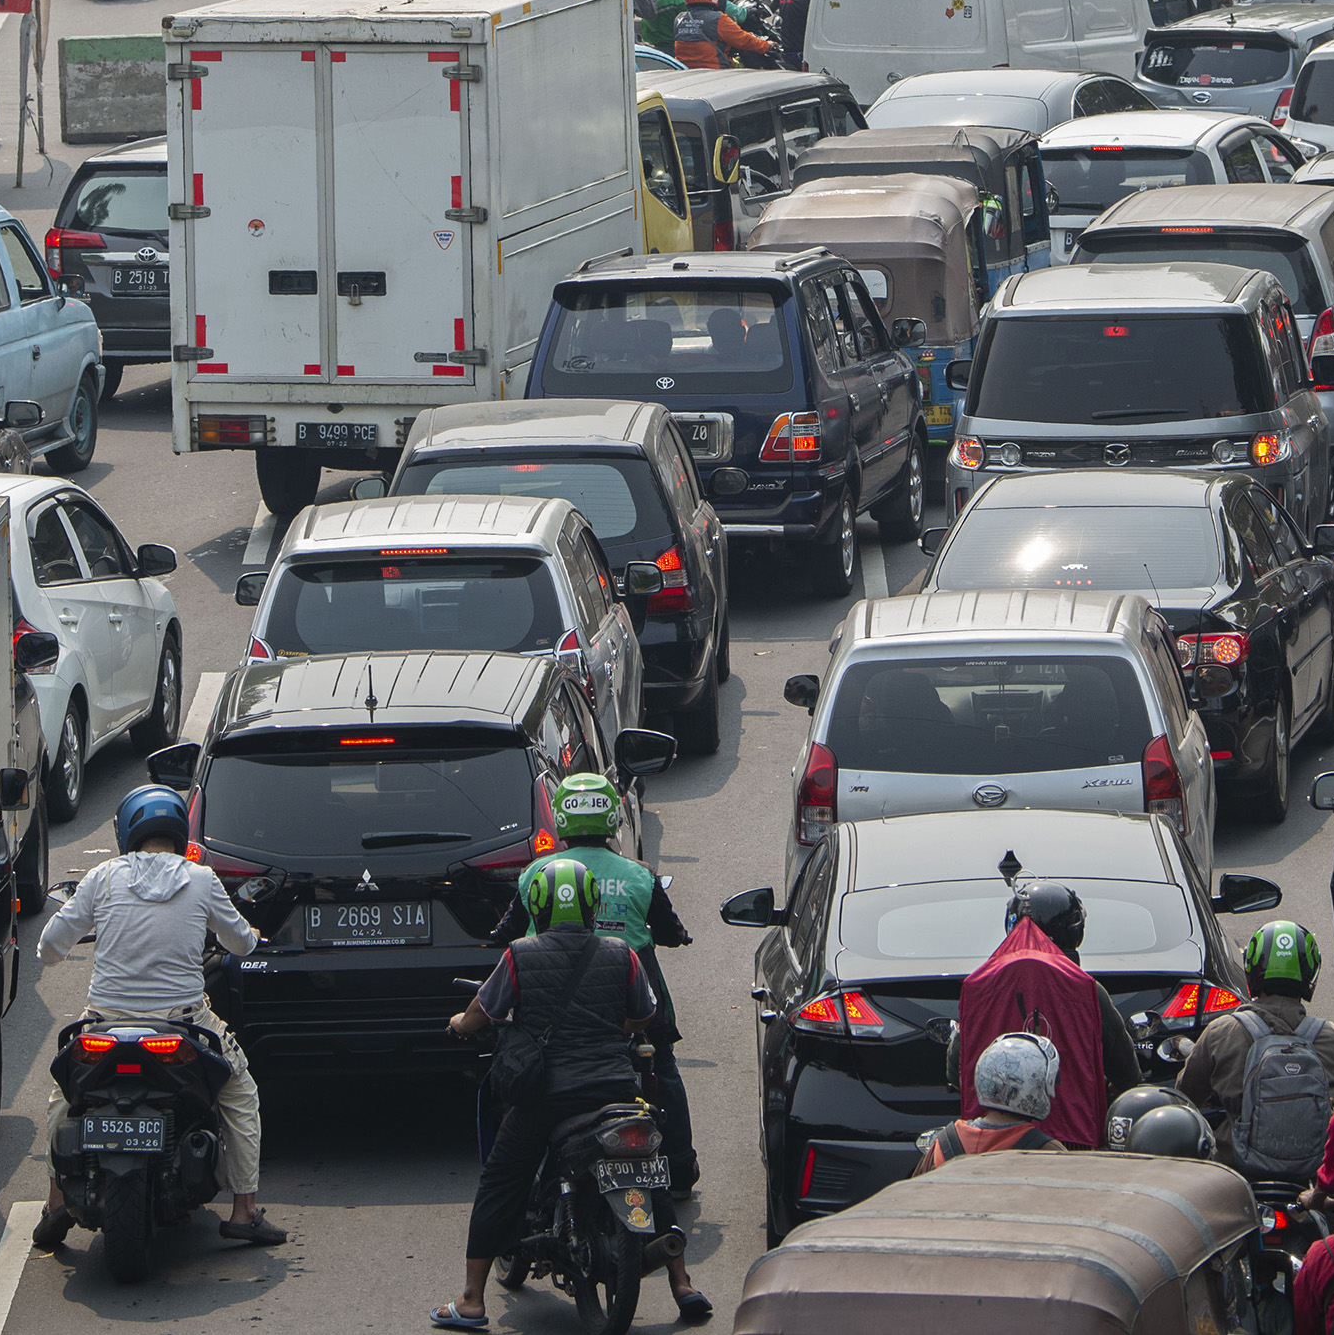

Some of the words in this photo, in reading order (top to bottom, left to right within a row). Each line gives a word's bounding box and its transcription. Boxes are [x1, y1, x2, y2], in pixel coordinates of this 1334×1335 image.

[1065, 232, 1074, 246] B
[114, 270, 123, 284] B
[128, 270, 155, 285] 2519
[299, 424, 307, 439] B
[319, 424, 348, 440] 9499
[353, 425, 375, 440] PCE
[1081, 777, 1133, 789] XENIA
[564, 798, 579, 810] GO
[591, 797, 609, 809] JEK
[558, 902, 574, 910] gojek
[310, 906, 322, 928] B
[337, 906, 381, 927] 2669
[392, 904, 425, 926] SIA
[87, 1120, 94, 1133] B
[102, 1121, 132, 1134] 5526
[139, 1121, 160, 1134] BCC
[598, 1164, 605, 1178] B
